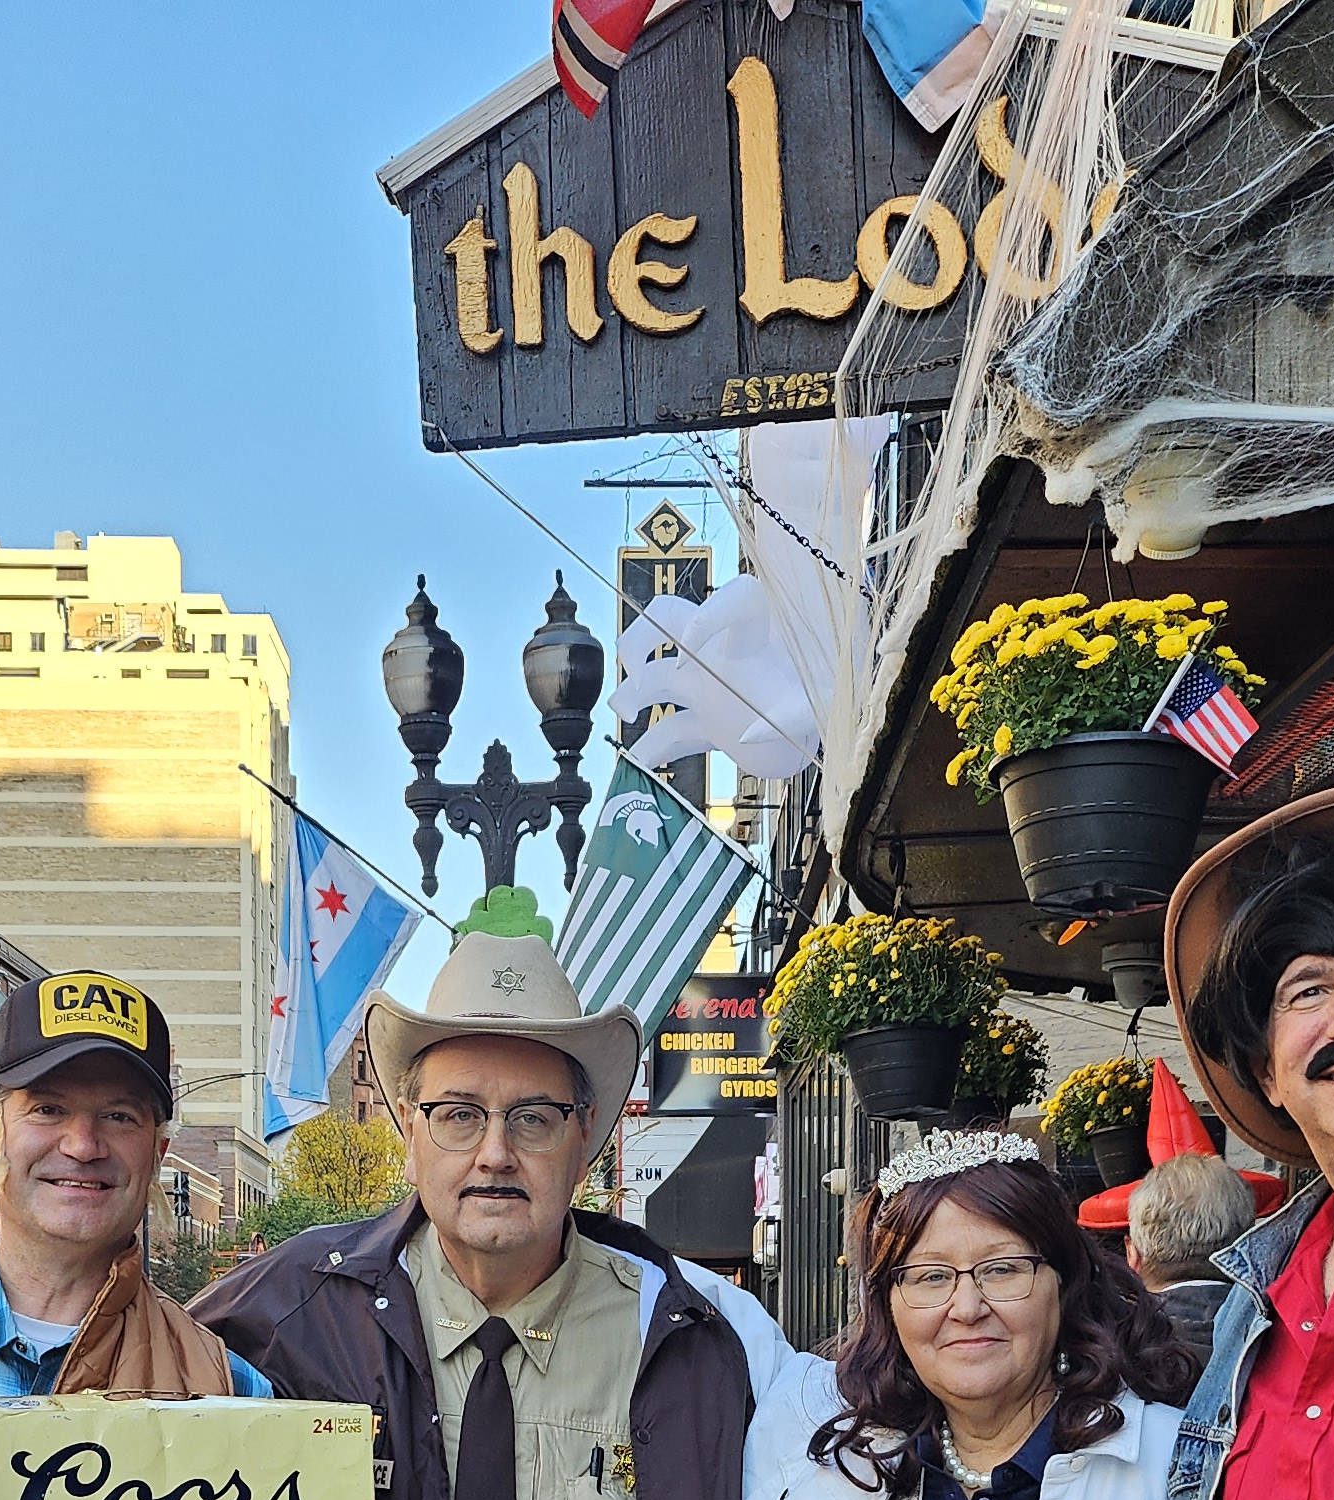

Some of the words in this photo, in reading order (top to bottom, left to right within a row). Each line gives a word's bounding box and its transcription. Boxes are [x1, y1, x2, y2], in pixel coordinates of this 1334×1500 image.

[444, 161, 707, 354] the
[727, 56, 1137, 325] Lod
[54, 984, 137, 1020] CAT
[667, 987, 779, 1019] erena'
[55, 1013, 95, 1024] DIESEL
[98, 1014, 138, 1036] POWER
[660, 1032, 735, 1051] CHICKEN
[720, 1079, 778, 1098] GYROS
[635, 1167, 663, 1181] RUN
[313, 1418, 334, 1434] 24
[338, 1425, 362, 1434] CANS
